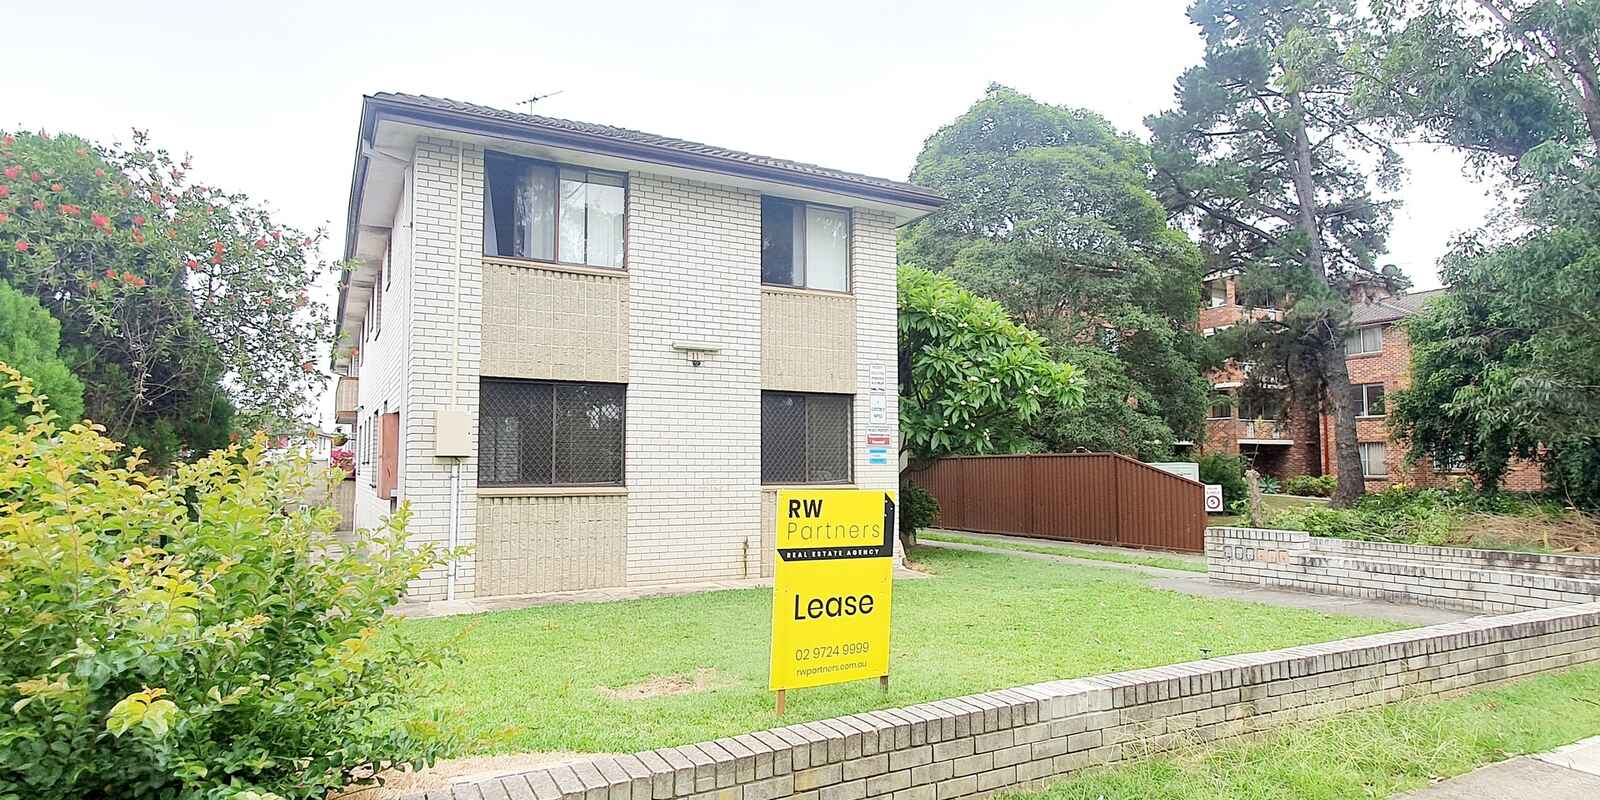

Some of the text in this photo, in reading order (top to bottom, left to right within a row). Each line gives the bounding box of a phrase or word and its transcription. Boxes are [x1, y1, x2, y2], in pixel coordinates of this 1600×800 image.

[788, 499, 823, 518] RW
[787, 522, 880, 540] Partners
[811, 550, 843, 558] ESTATE
[846, 548, 880, 557] AGENCY
[794, 594, 874, 620] Lease
[795, 641, 870, 661] 02 9724 9999
[796, 661, 867, 677] rwpartners.com.au
